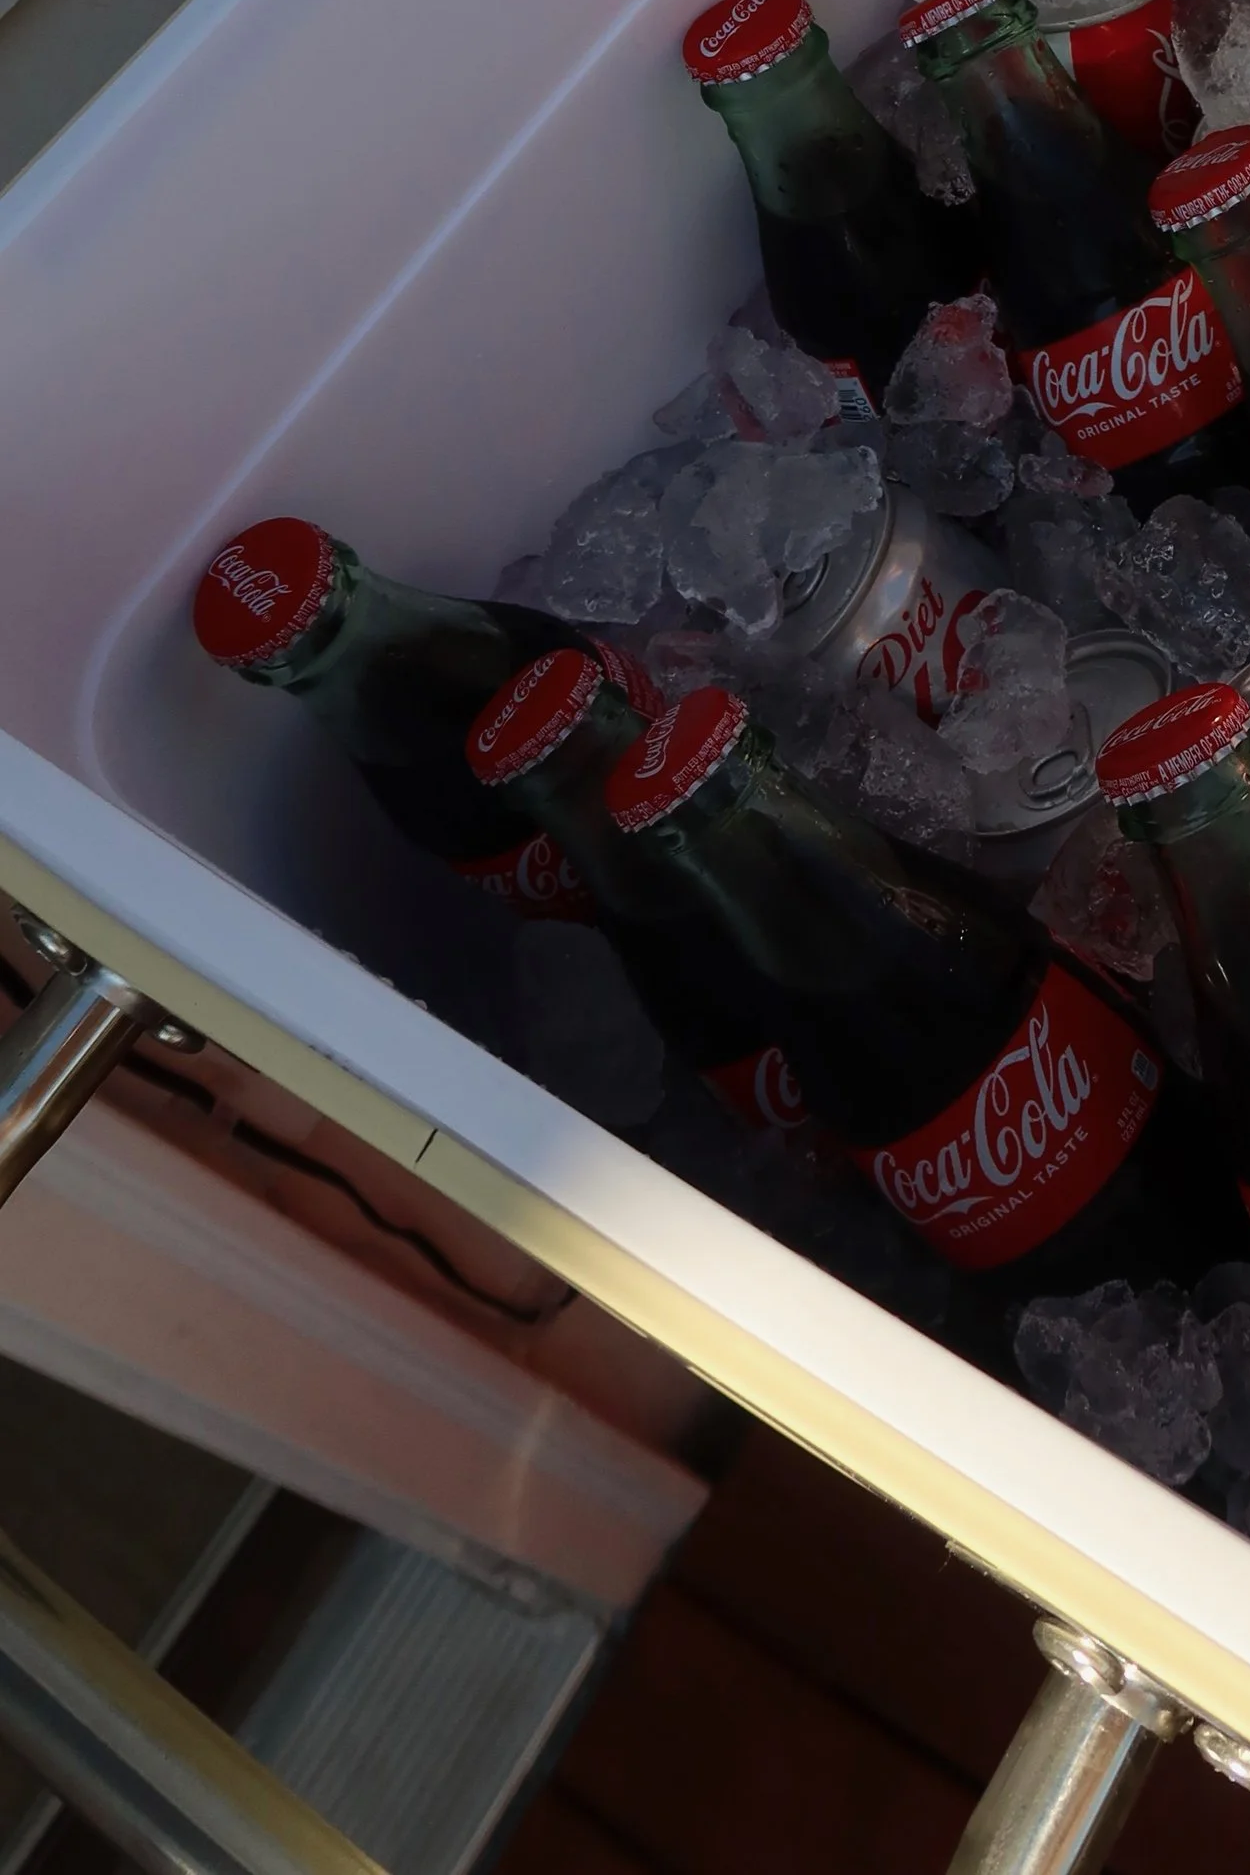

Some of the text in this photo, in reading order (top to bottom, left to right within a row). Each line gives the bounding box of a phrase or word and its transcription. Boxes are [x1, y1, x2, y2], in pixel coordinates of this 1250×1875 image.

[1032, 271, 1214, 426] Coca-Cola
[1077, 373, 1202, 441] ORIGINAL TASTE
[208, 545, 293, 616] Coca-Cola
[856, 577, 944, 692] Diet
[477, 651, 558, 753] Coca-Cola
[671, 757, 701, 784] BOTTLED
[1157, 725, 1232, 783] A MEMBER OF THE
[873, 999, 1092, 1225] Coca-Cola
[948, 1124, 1089, 1240] ORIGINAL TASTE
